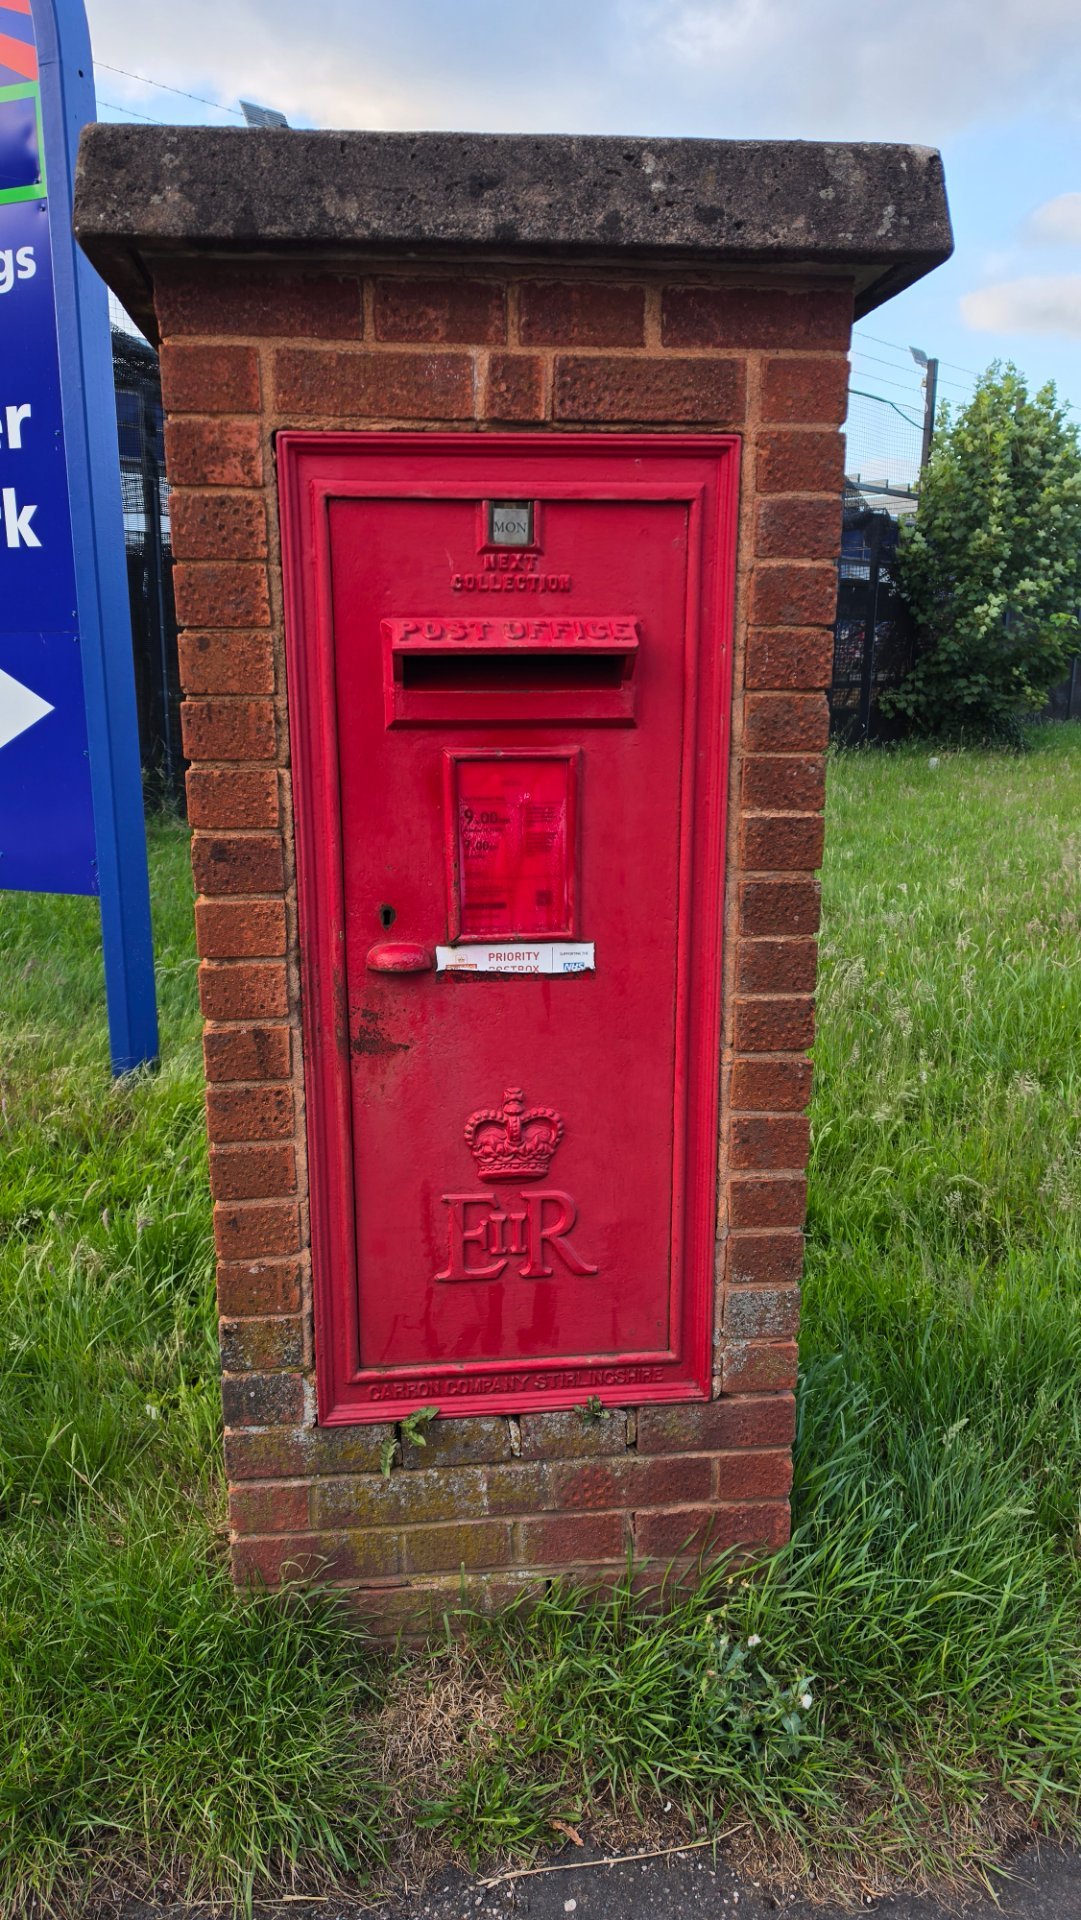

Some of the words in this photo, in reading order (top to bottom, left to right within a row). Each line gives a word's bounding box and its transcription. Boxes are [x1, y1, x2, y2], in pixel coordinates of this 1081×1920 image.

[0, 404, 32, 449] r
[0, 487, 42, 547] k
[494, 521, 527, 533] MON
[483, 553, 538, 571] NEXT
[451, 574, 572, 593] COLLECTION
[399, 620, 492, 642] POST
[502, 619, 635, 641] OFFICE
[488, 951, 540, 962] PRIORITY
[564, 962, 585, 971] NHS
[368, 1381, 440, 1400] CARRON
[446, 1375, 530, 1395] COMPANY
[534, 1367, 664, 1390] STIRLINGSHIRE
